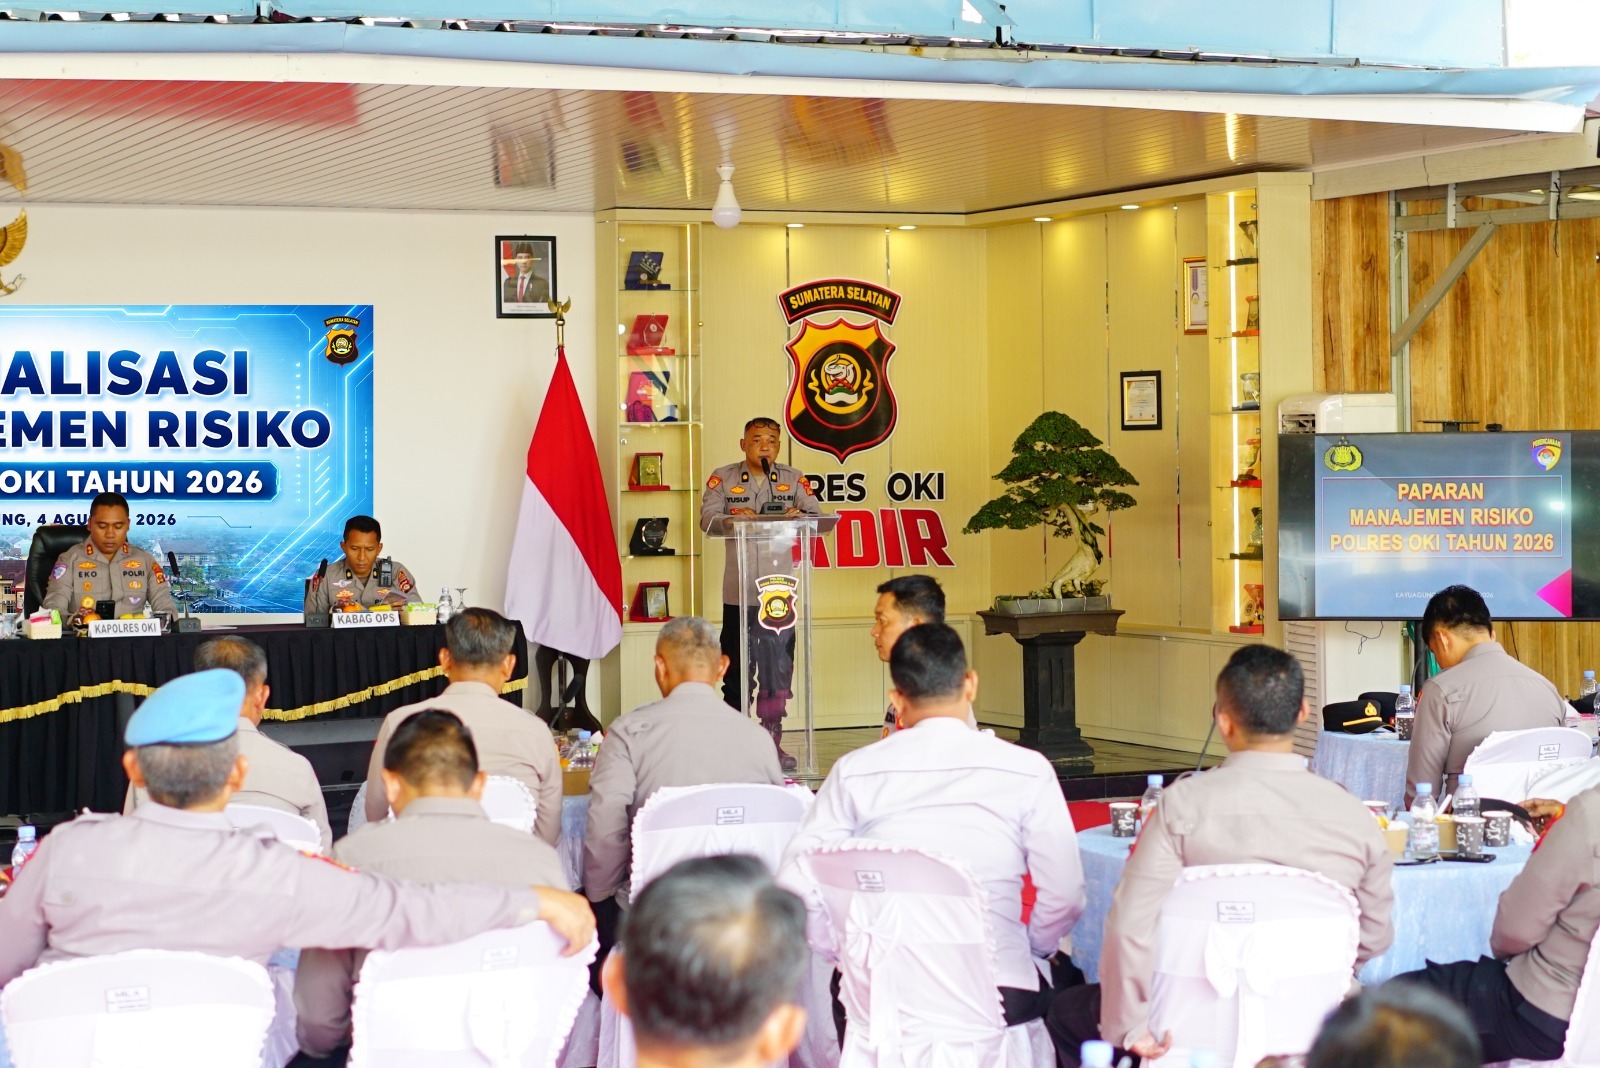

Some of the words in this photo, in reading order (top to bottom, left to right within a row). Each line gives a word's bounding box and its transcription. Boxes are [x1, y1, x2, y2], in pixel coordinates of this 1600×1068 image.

[789, 285, 845, 309] SUMATERA
[846, 285, 892, 310] SELATAN
[0, 349, 248, 396] ALISASI
[0, 410, 127, 448] MEN
[148, 409, 331, 448] RISIKO
[0, 469, 56, 494] OKI
[66, 469, 175, 494] TAHUN
[186, 469, 263, 494] 2026
[887, 472, 945, 502] OKI
[1398, 482, 1484, 501] PAPARAN
[37, 513, 47, 525] 4
[135, 513, 177, 526] 2026
[1350, 508, 1465, 527] MANAJEMEN
[1470, 507, 1534, 527] RISIKO
[1330, 533, 1403, 552] POLRES
[1408, 533, 1440, 552] OKI
[1445, 533, 1507, 552] TAHUN
[1512, 533, 1555, 552] 2026
[78, 570, 98, 578] EKO
[122, 569, 146, 577] POLRI
[94, 622, 140, 635] KAPOLRES
[141, 621, 158, 633] OKI
[337, 613, 373, 625] KABAG
[375, 612, 396, 623] OPS
